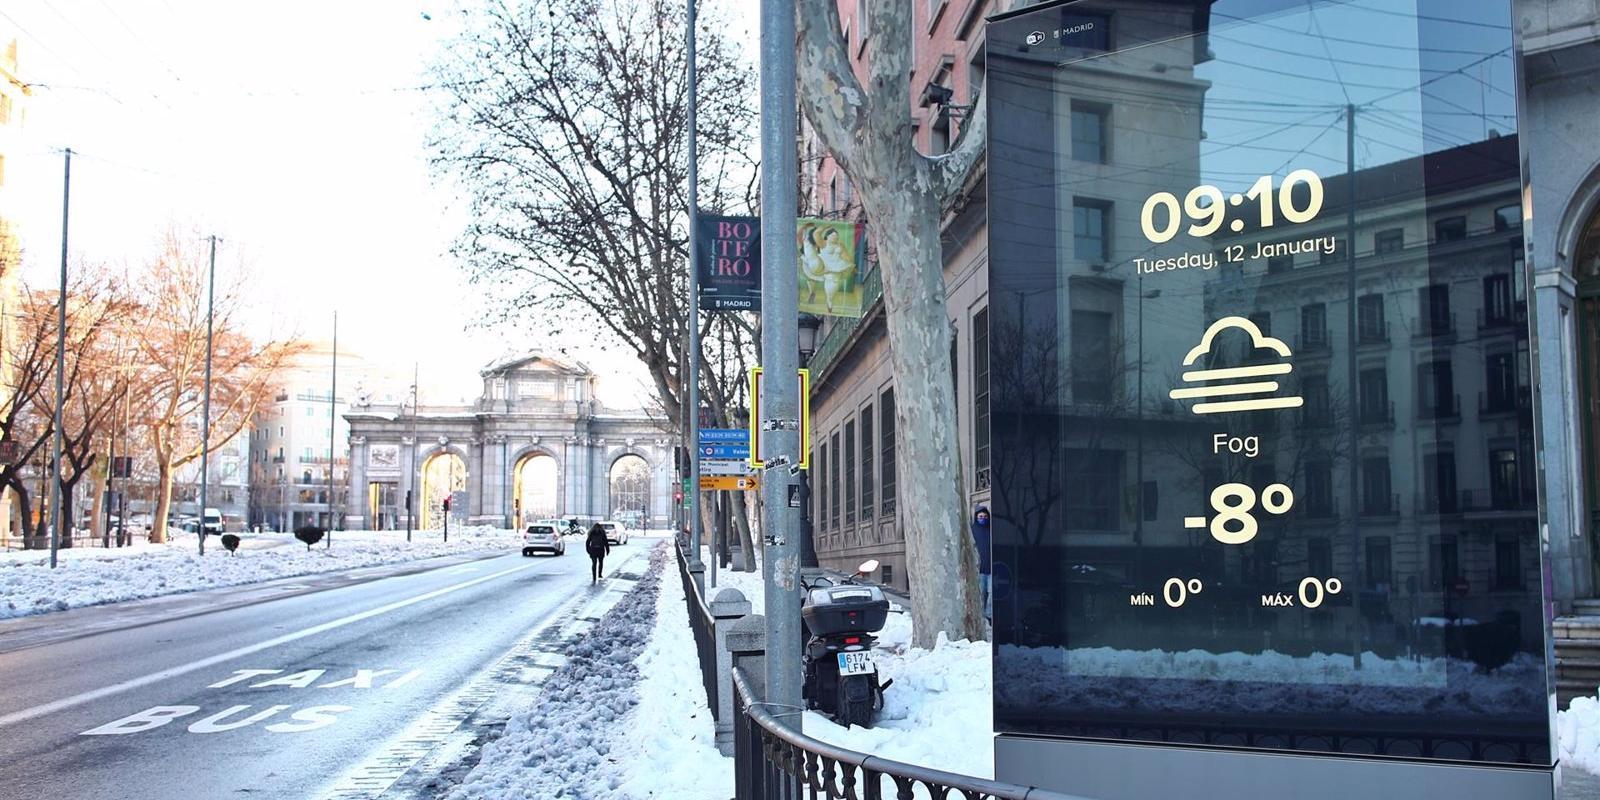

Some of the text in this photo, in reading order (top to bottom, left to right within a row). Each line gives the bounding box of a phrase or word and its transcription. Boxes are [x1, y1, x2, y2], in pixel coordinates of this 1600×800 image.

[1062, 22, 1095, 36] MADRID
[1140, 168, 1324, 244] 09:10
[718, 221, 752, 239] BO
[717, 239, 750, 257] TE
[1133, 236, 1336, 274] Tuesday, 12 January
[718, 257, 752, 277] RO
[723, 299, 752, 308] MADRID
[1213, 432, 1260, 458] Fog
[1130, 592, 1154, 606] MÍN
[1261, 592, 1293, 607] MÁX
[846, 652, 871, 664] 6174
[206, 668, 425, 689] TAXI
[78, 703, 354, 736] BUS
